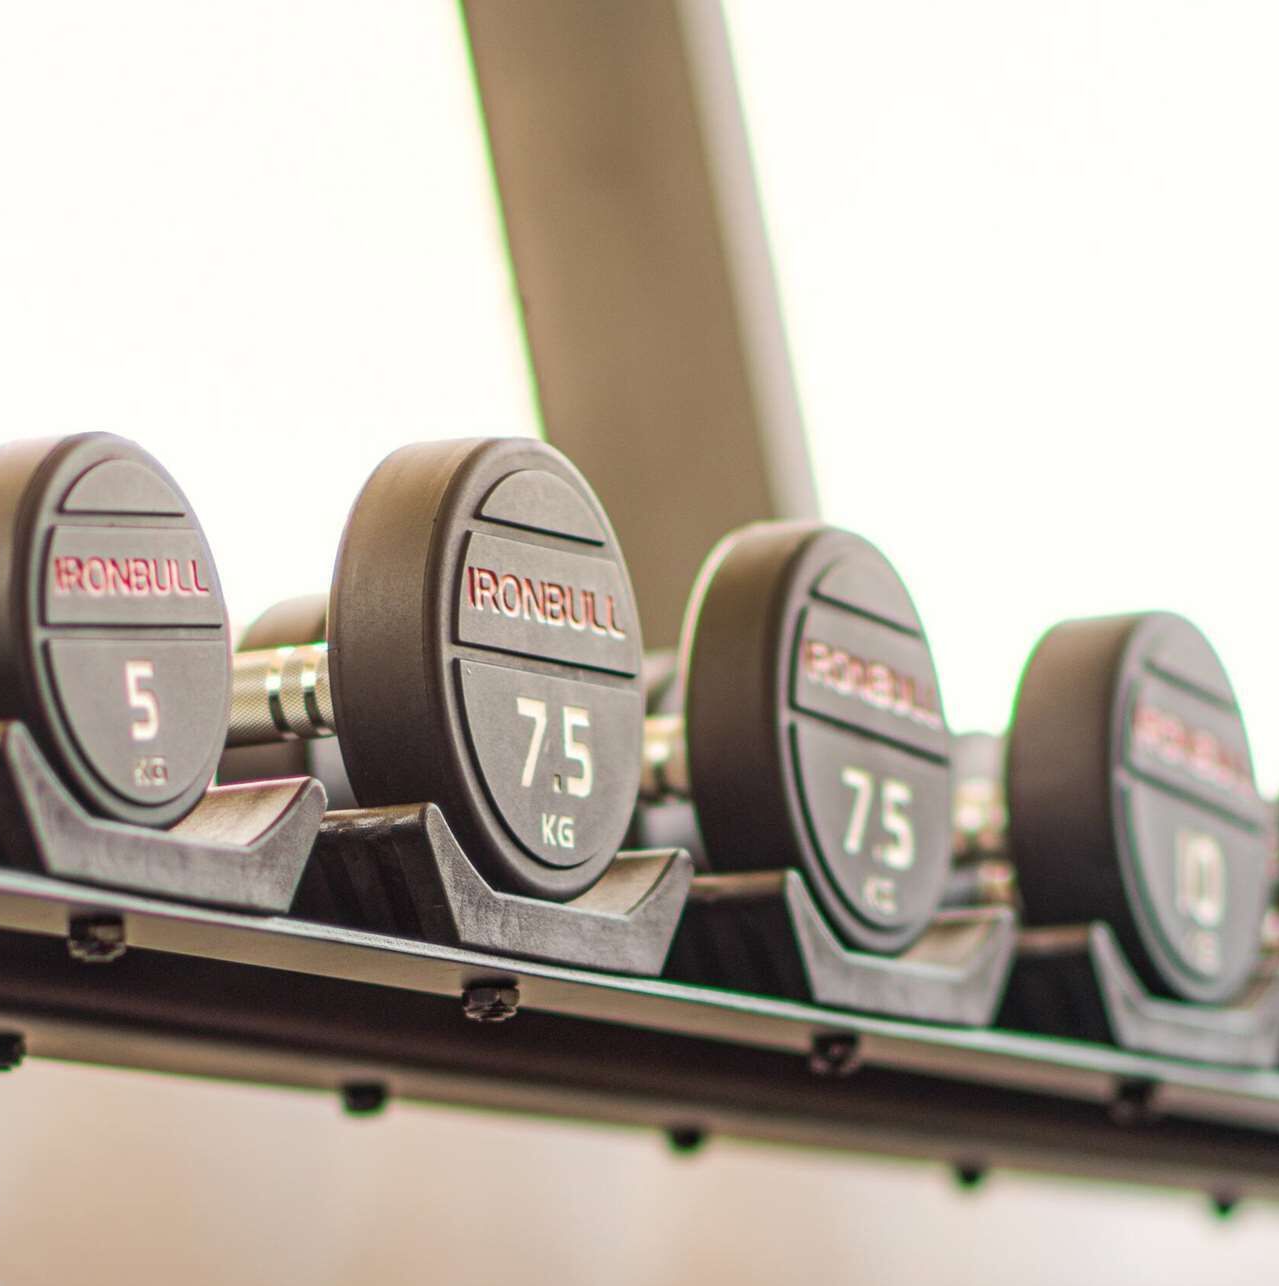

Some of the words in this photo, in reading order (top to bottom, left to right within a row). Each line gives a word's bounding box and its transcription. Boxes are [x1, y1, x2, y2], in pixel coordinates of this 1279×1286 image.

[54, 556, 210, 595] IRONBULL
[467, 566, 626, 640] IRONBULL
[125, 660, 159, 740] 5
[516, 697, 593, 798] 7.5
[541, 812, 574, 848] KG
